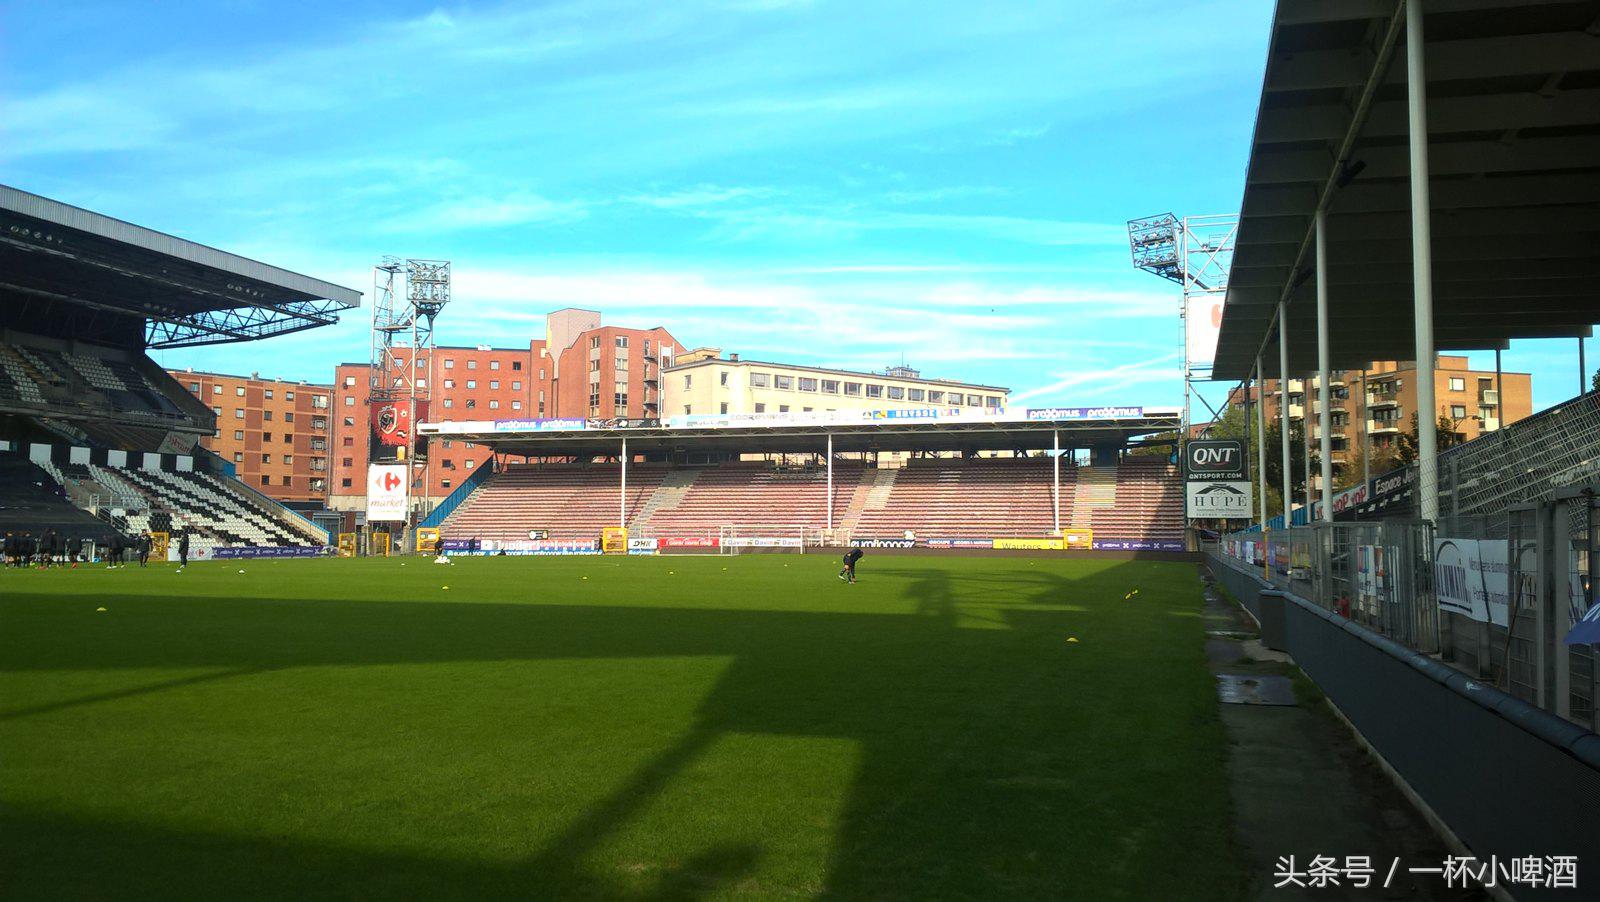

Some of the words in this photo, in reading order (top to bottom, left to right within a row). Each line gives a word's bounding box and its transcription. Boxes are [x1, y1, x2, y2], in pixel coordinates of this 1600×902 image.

[1030, 409, 1080, 418] proximus
[1087, 407, 1139, 417] proximus
[496, 420, 537, 430] proximus
[541, 419, 583, 429] proximus
[1193, 448, 1236, 465] QNT
[1375, 475, 1401, 495] Espace
[370, 499, 403, 508] market
